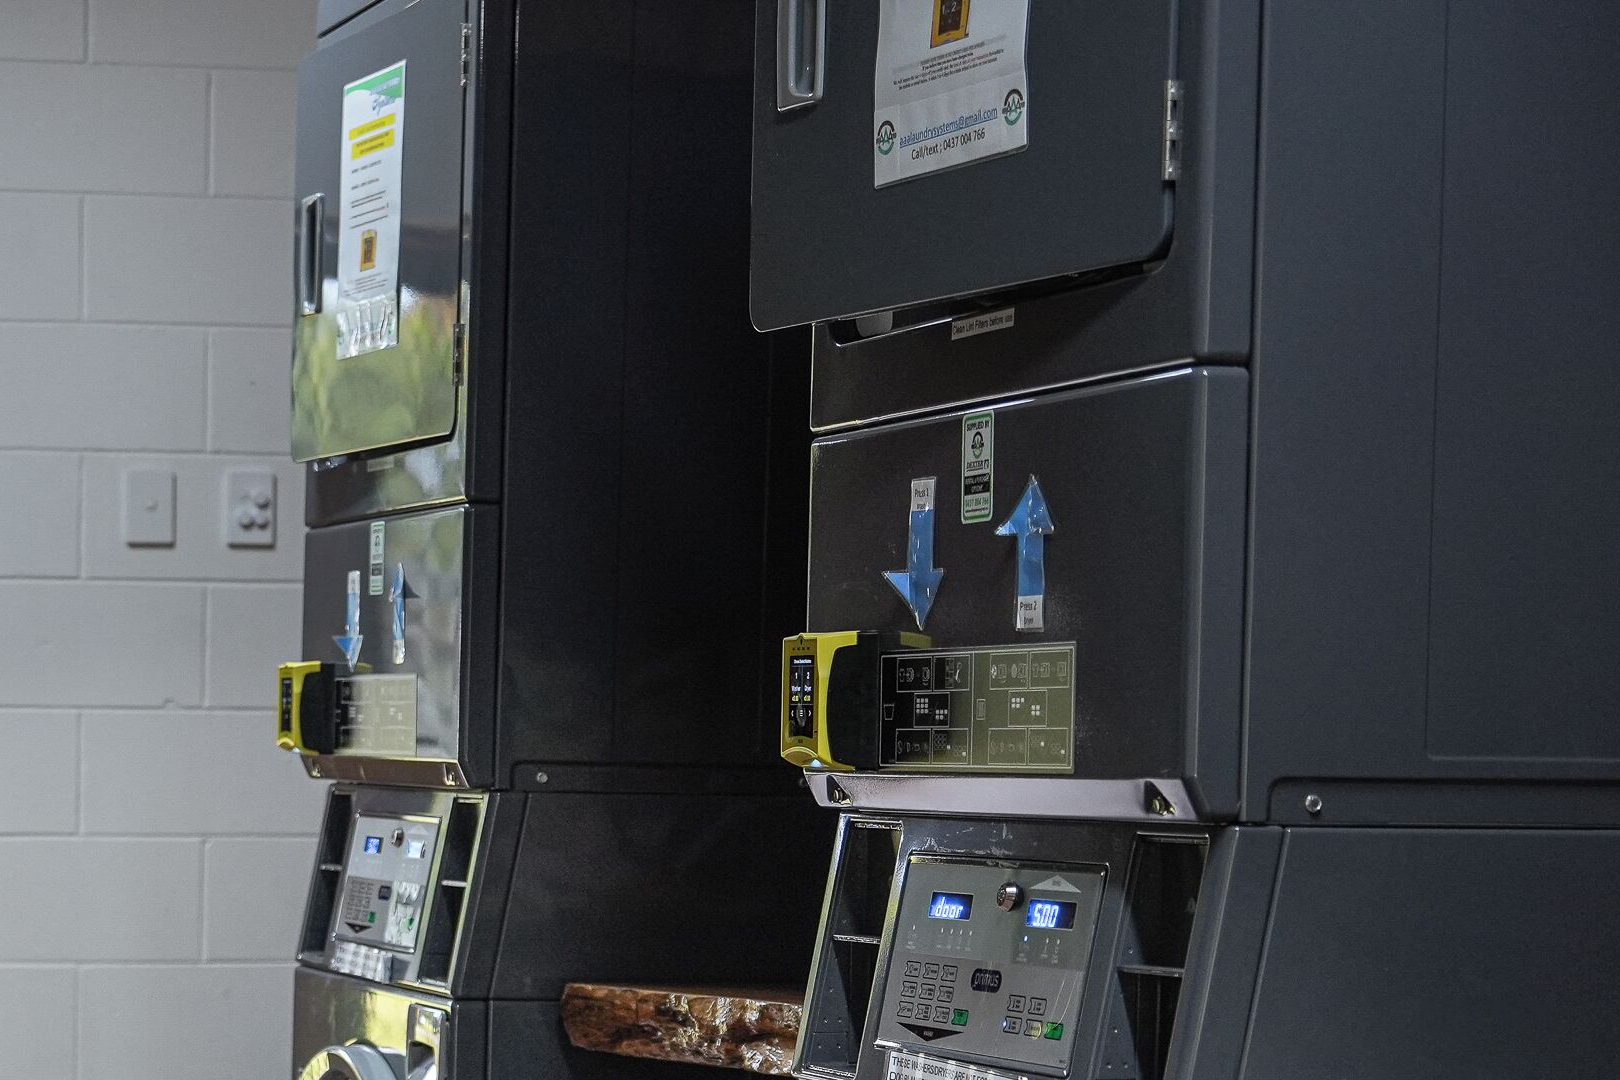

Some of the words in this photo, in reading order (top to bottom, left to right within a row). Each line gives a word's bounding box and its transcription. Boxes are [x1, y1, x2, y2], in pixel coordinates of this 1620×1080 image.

[911, 143, 939, 160] Call/text
[943, 136, 959, 151] 0437
[960, 133, 972, 146] 004
[973, 128, 986, 141] 766
[966, 421, 984, 432] SUPPLIED
[914, 489, 926, 498] Press
[1020, 601, 1033, 611] Press
[935, 897, 964, 919] door
[974, 971, 1000, 988] primus
[892, 1056, 910, 1069] THESE
